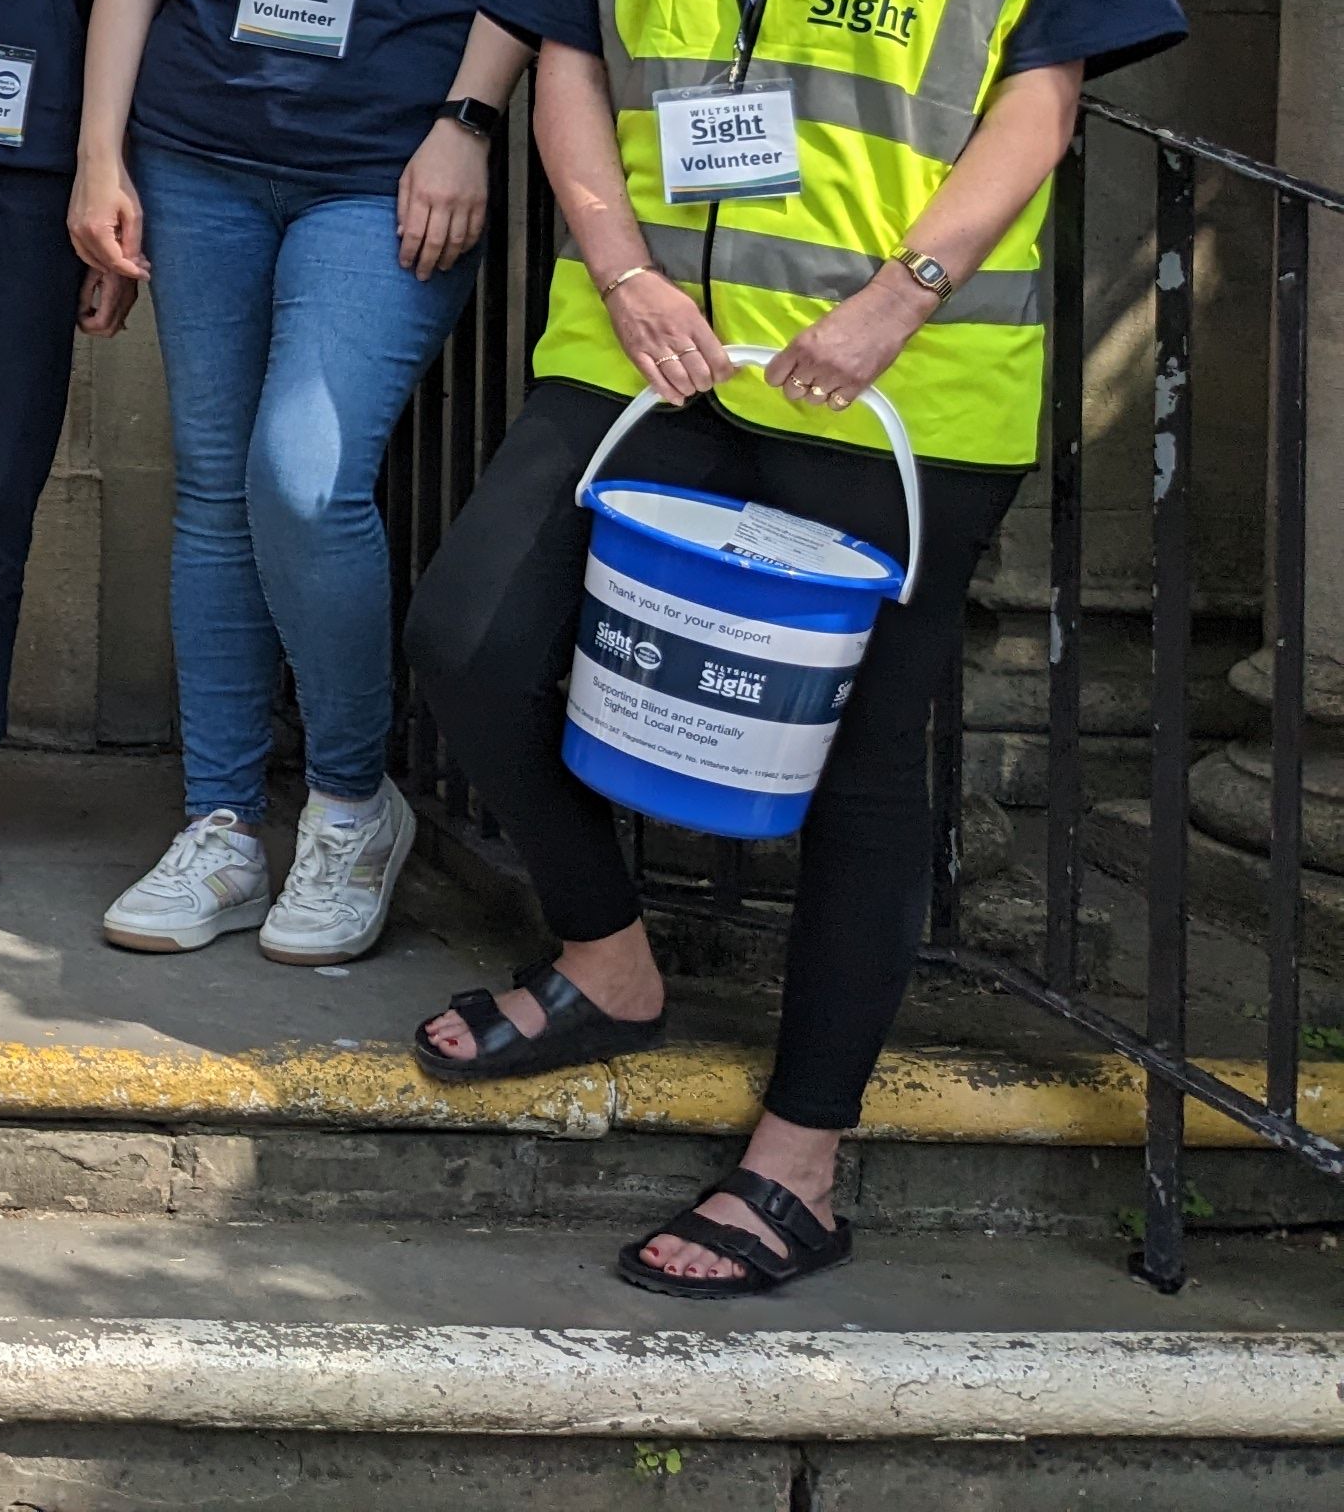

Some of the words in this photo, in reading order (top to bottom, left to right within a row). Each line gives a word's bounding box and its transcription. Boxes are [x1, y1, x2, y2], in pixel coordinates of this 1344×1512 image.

[253, 1, 336, 27] Volunteer
[690, 103, 763, 117] WILTSHIRE
[691, 114, 766, 143] Sight
[680, 148, 783, 172] Volunteer
[608, 580, 636, 603] Thank
[639, 596, 660, 612] you
[663, 604, 681, 619] for
[683, 613, 715, 630] your
[718, 625, 772, 645] support
[596, 621, 633, 653] Sight
[698, 669, 762, 702] Sight
[704, 661, 767, 682] WILTSHIRE
[592, 676, 638, 707] Supporting
[641, 700, 668, 717] Blind
[671, 711, 694, 726] and
[697, 719, 744, 740] Partially
[604, 697, 638, 720] Sighted
[644, 715, 674, 734] Local
[677, 726, 719, 746] People
[657, 745, 682, 759] Charity
[730, 765, 748, 775] Sight
